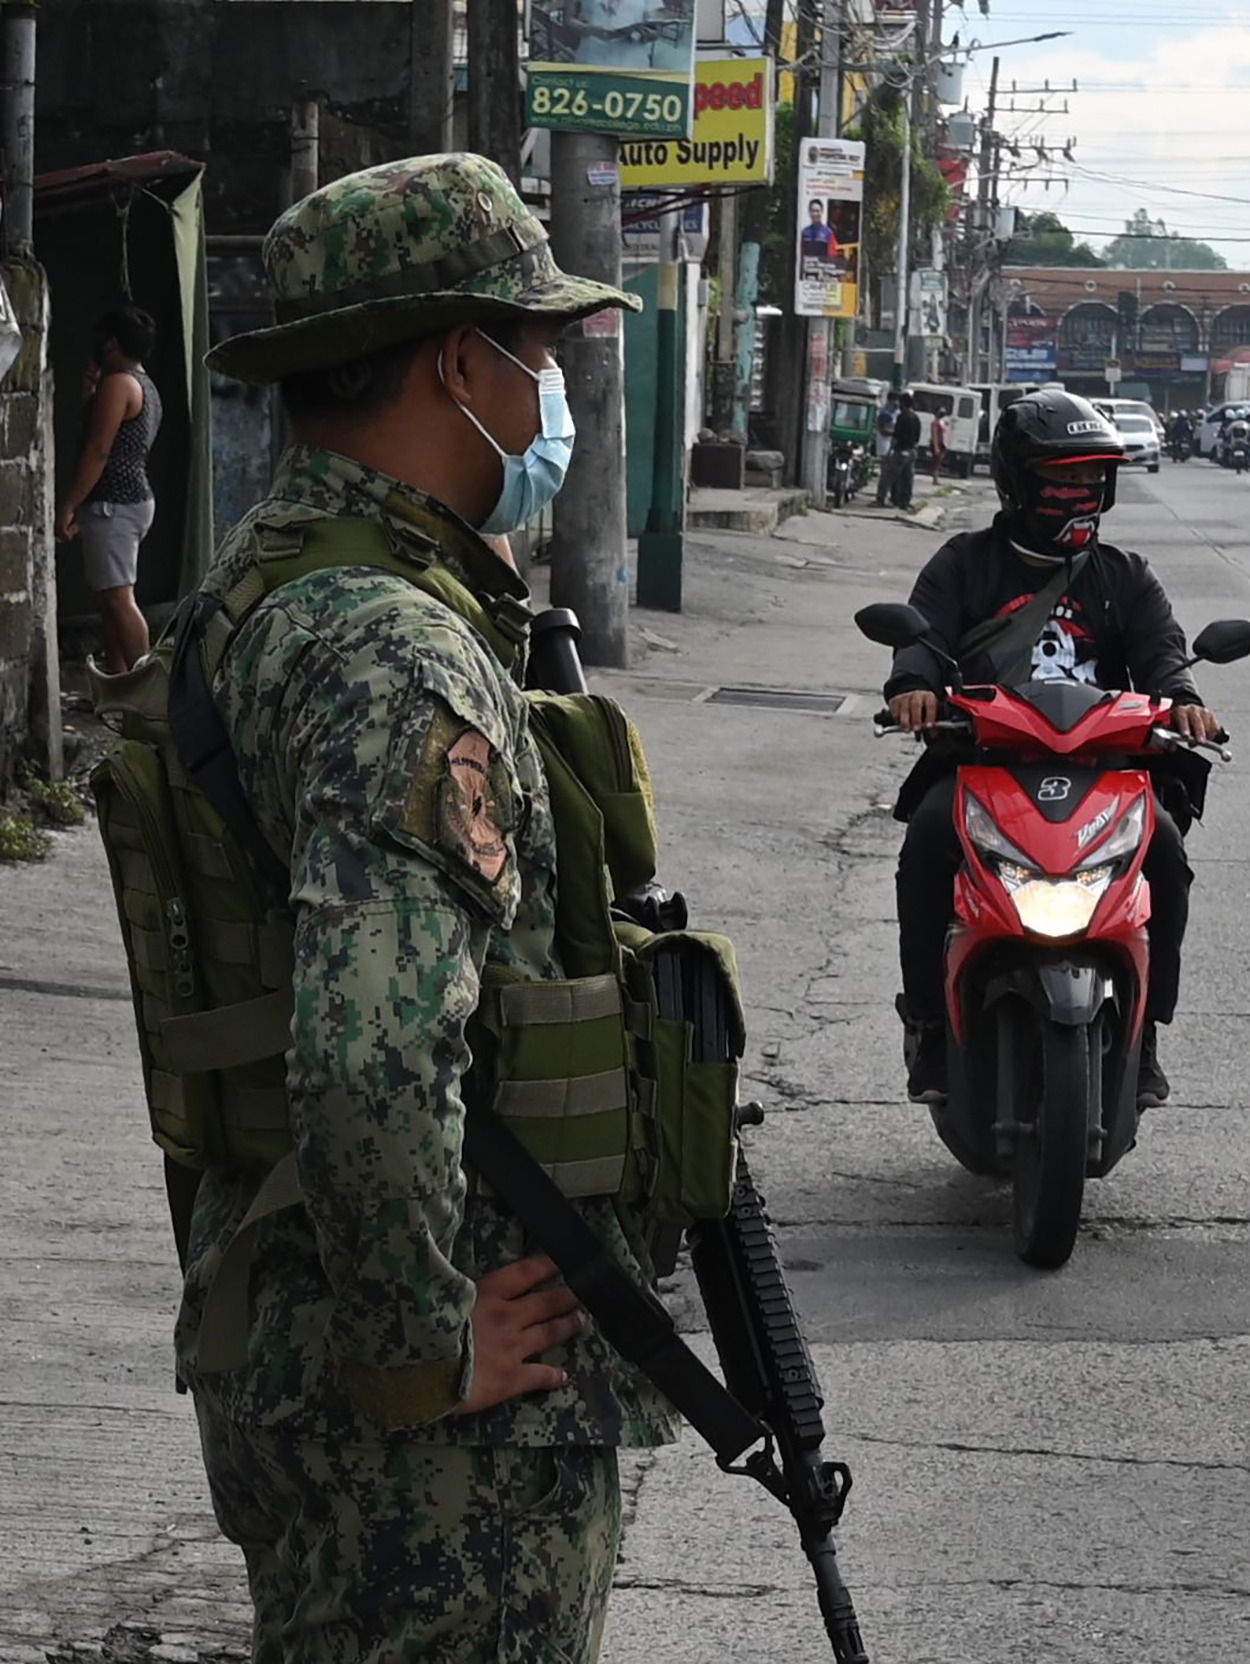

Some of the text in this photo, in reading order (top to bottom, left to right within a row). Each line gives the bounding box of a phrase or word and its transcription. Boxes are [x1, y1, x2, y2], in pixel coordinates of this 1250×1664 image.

[532, 87, 682, 122] 826-0750
[694, 72, 764, 120] peed
[676, 133, 759, 170] Supply
